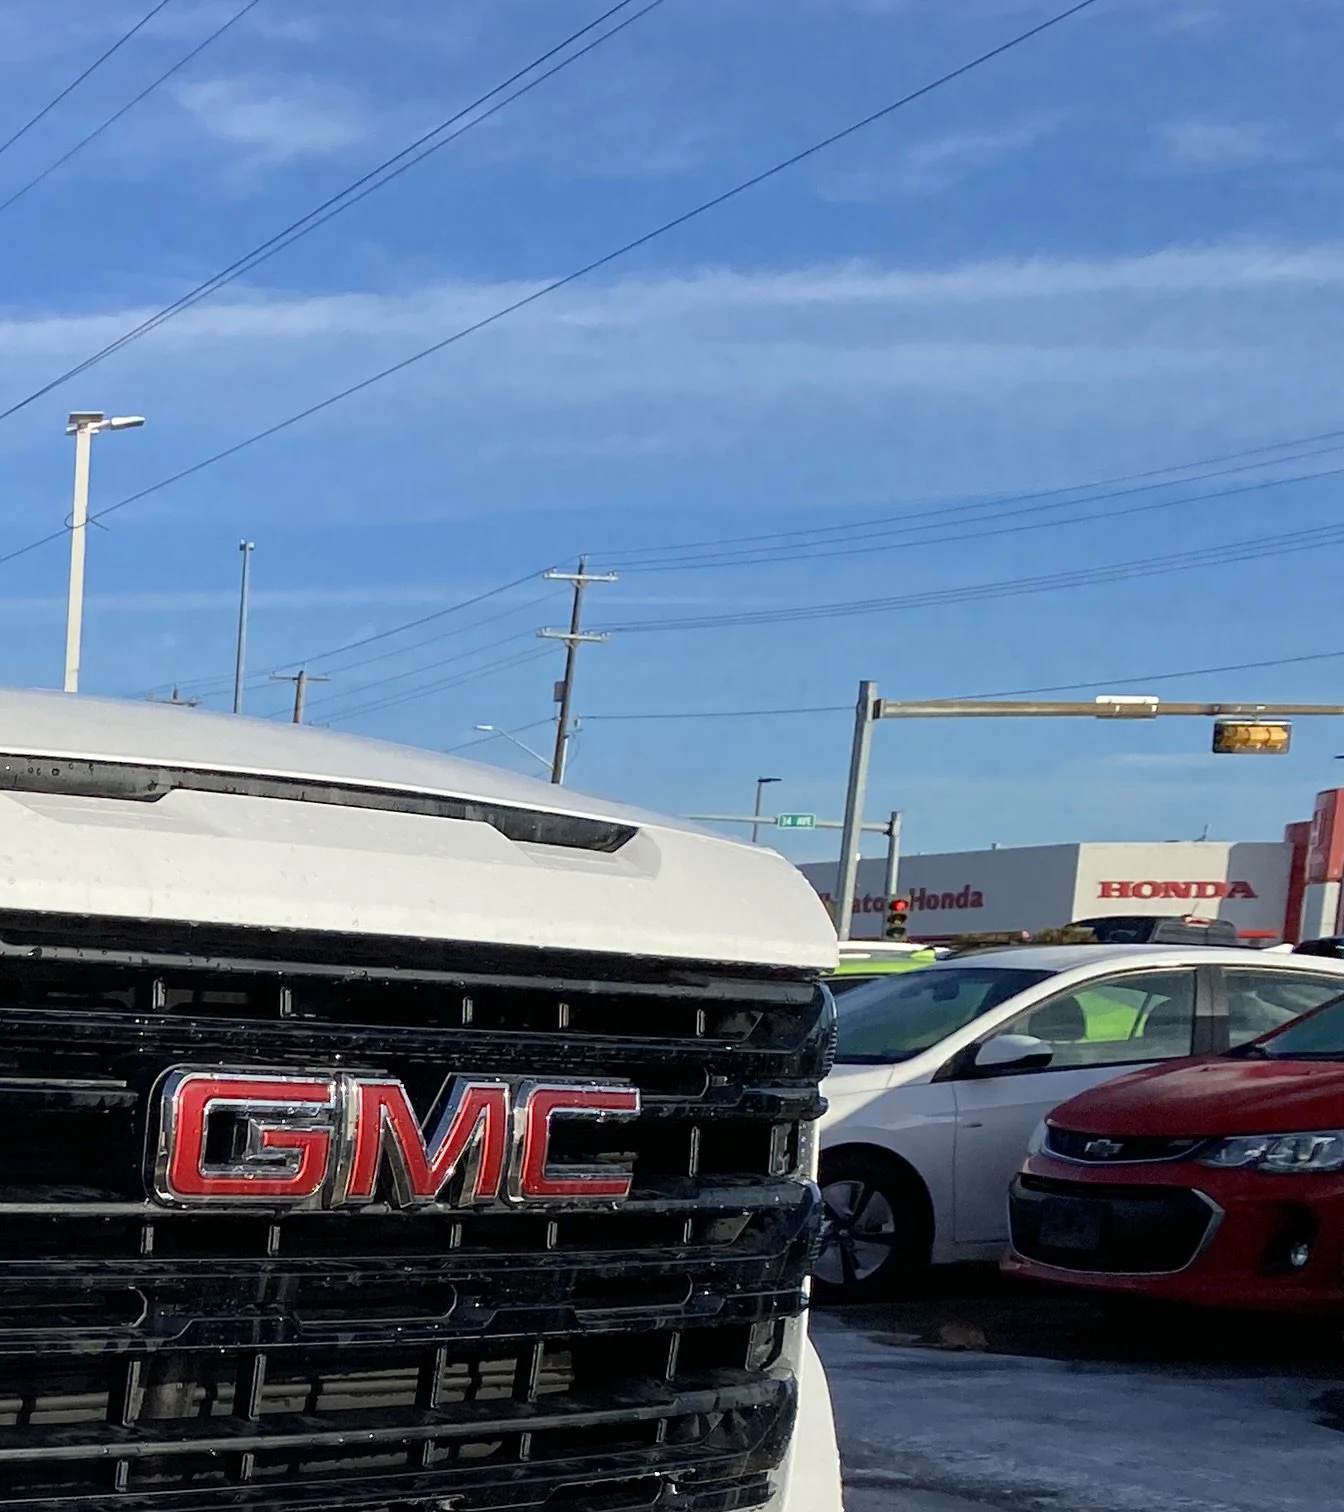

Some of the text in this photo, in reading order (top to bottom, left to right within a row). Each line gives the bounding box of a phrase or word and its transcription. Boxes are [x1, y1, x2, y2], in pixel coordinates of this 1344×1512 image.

[908, 884, 984, 912] Honda
[1097, 881, 1258, 899] HONDA
[145, 1064, 641, 1208] GMC
